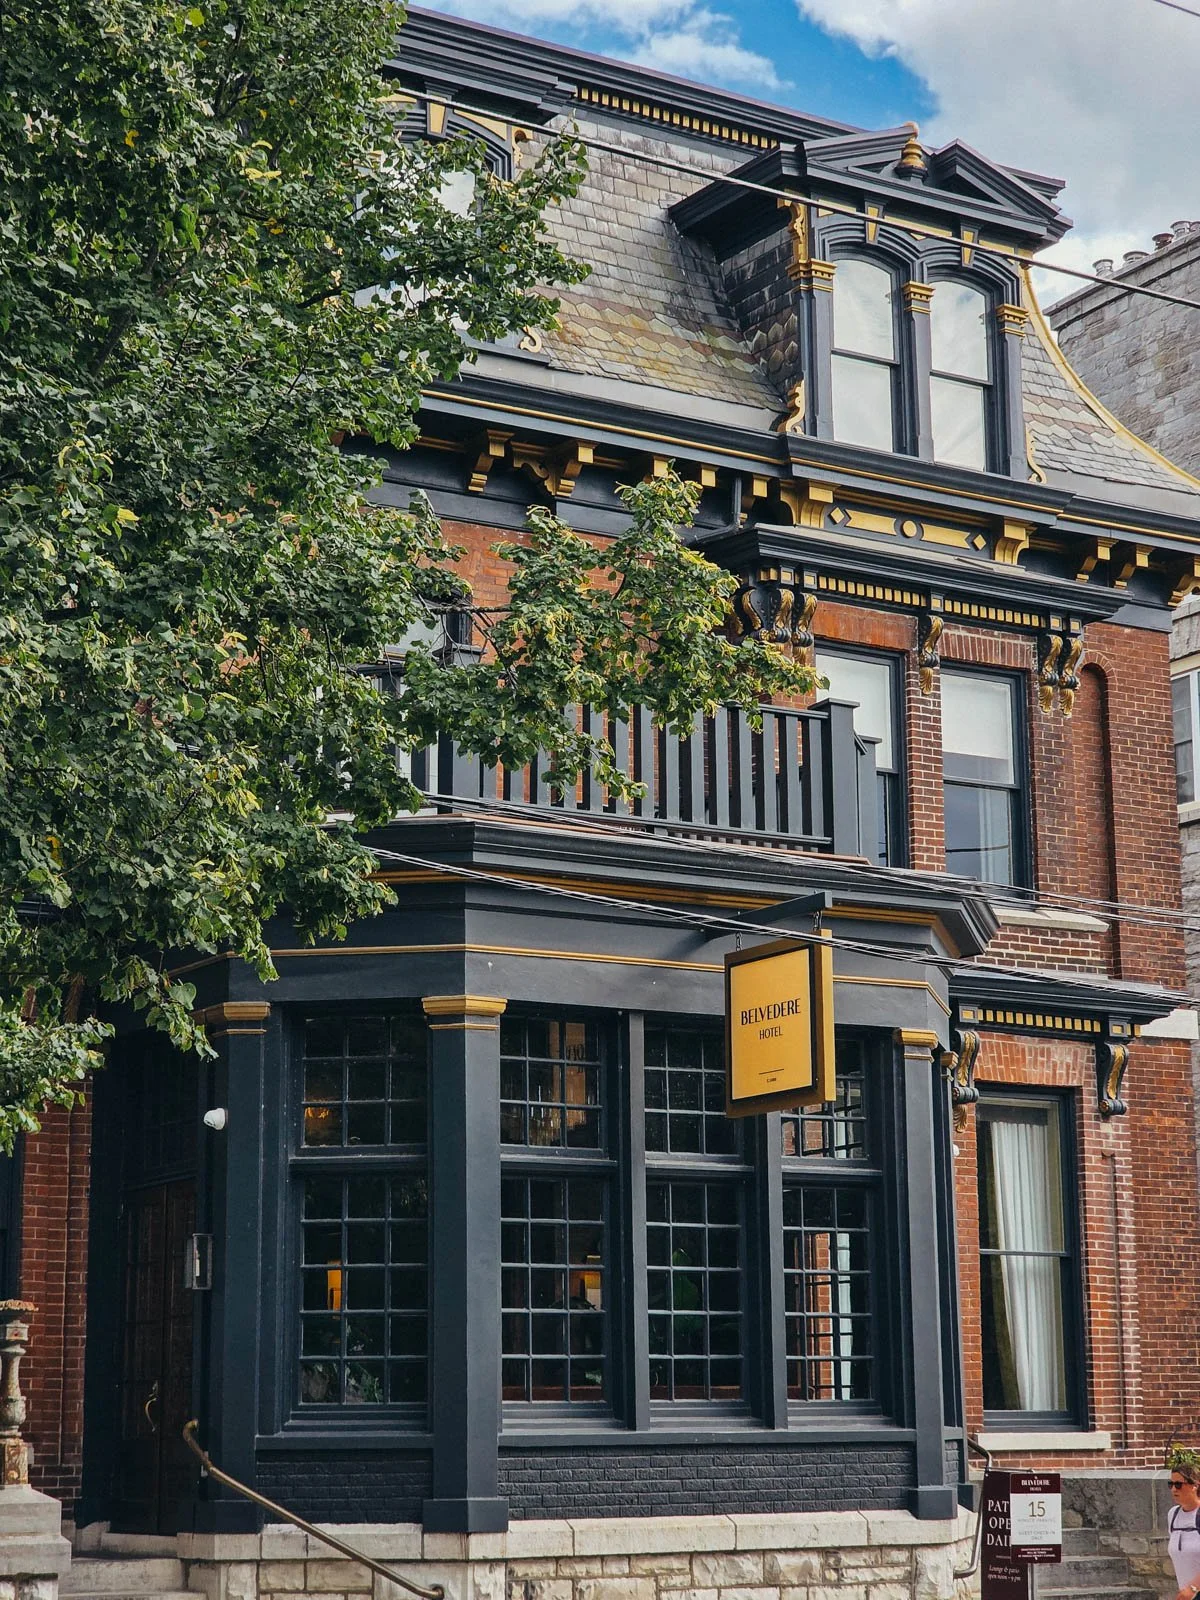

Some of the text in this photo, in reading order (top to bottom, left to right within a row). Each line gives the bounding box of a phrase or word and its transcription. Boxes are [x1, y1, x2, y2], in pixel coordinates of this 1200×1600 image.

[741, 998, 801, 1026] BELVEDERE
[760, 1025, 783, 1040] HOTEL
[988, 1499, 1010, 1512] PAT
[1028, 1501, 1046, 1517] 15
[989, 1516, 1012, 1530] OPE
[987, 1533, 1012, 1547] DAI
